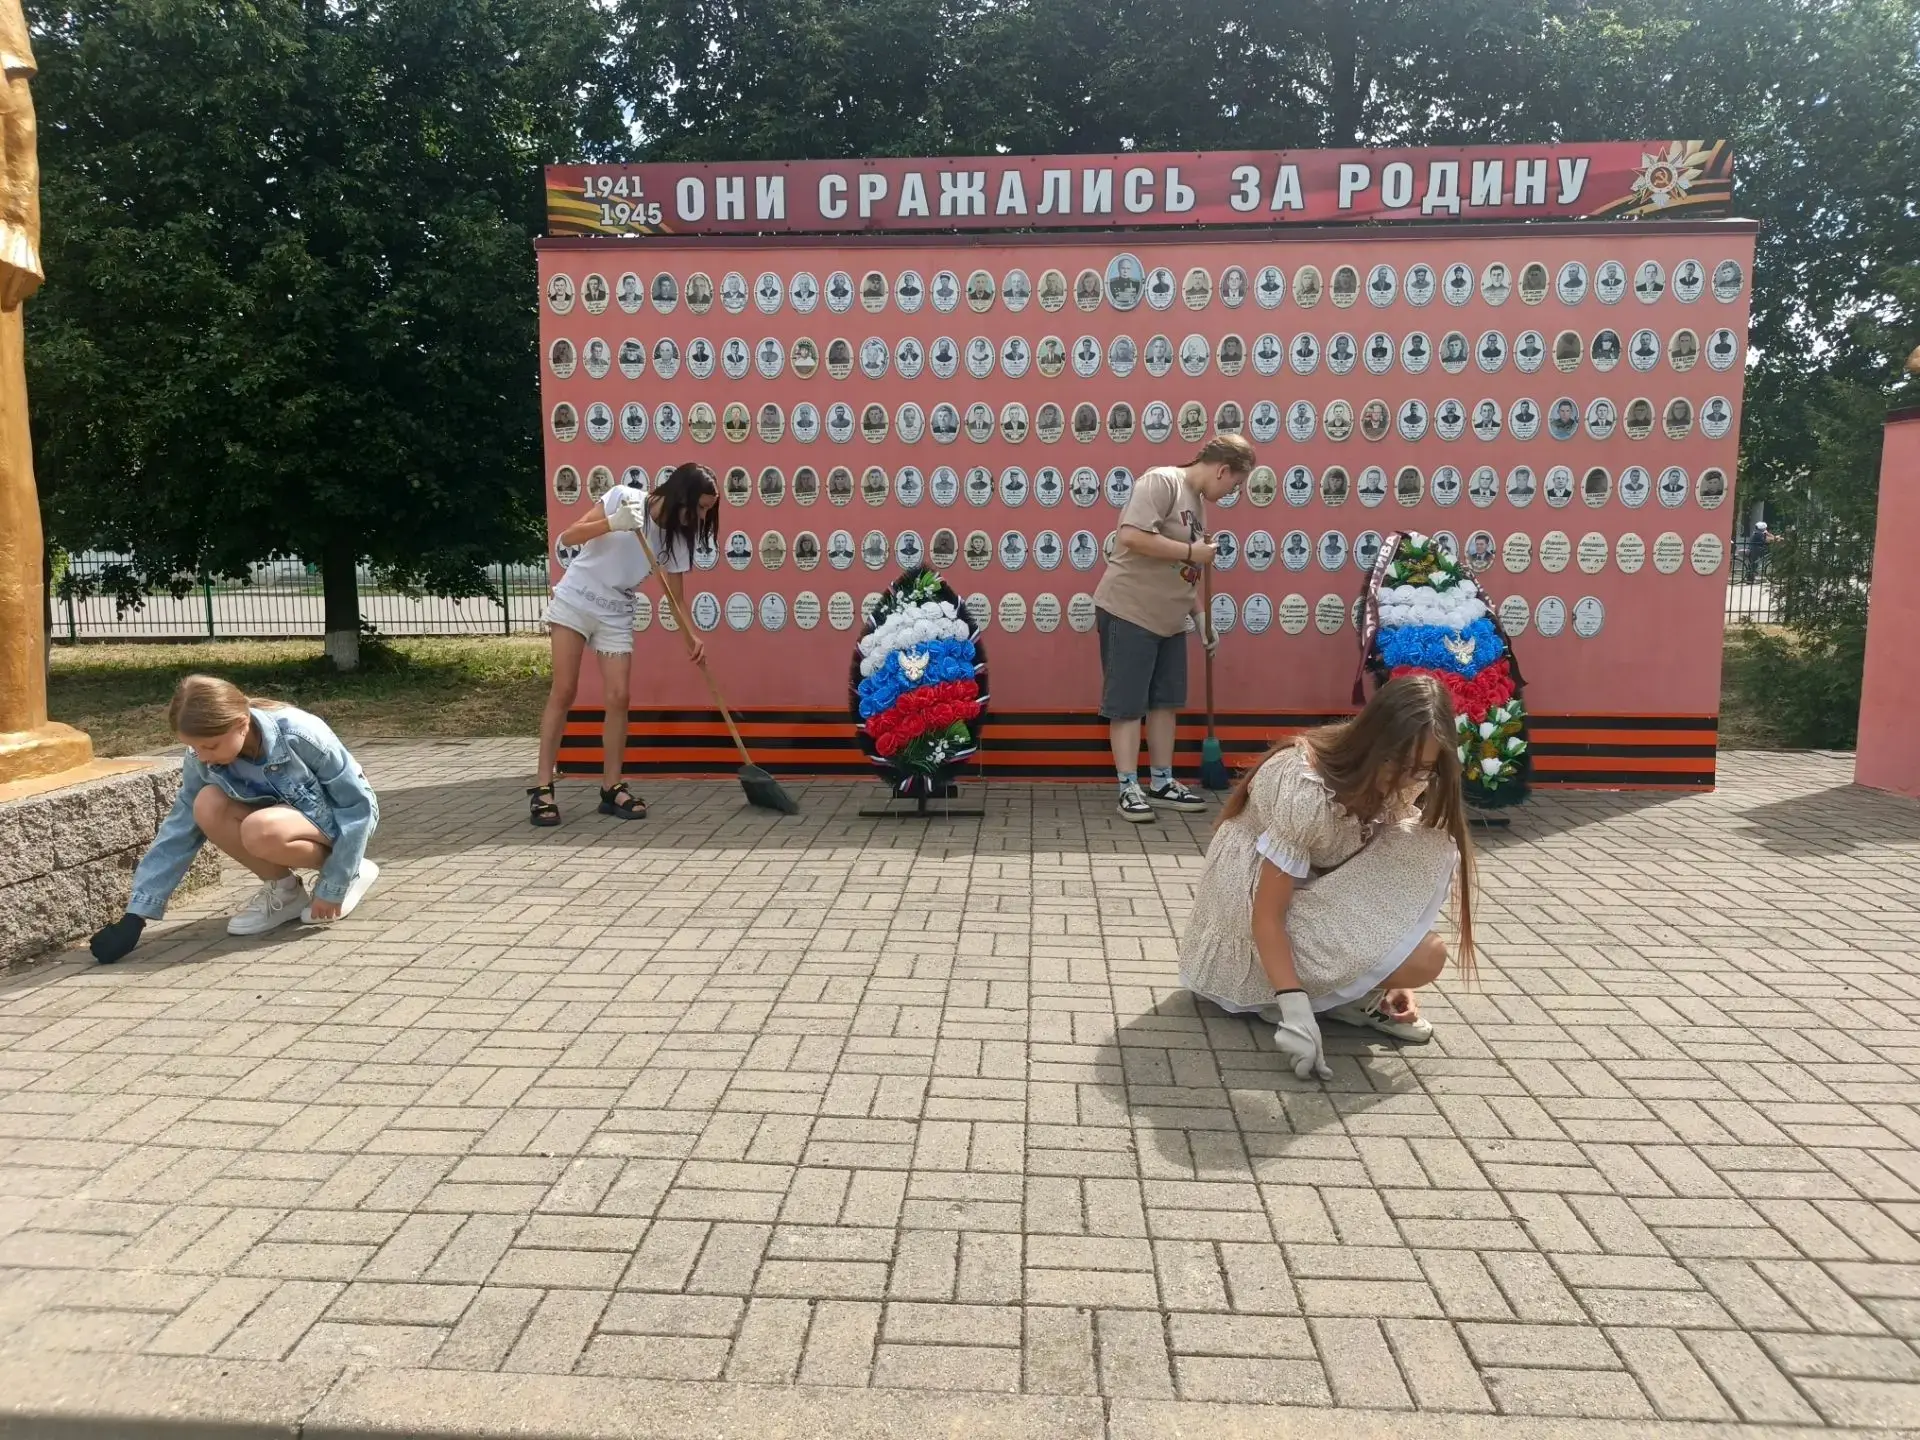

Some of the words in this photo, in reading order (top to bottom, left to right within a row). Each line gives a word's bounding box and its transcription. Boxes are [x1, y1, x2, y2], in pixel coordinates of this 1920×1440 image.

[583, 175, 644, 199] 1941
[675, 175, 785, 223] ОНИ
[817, 166, 1197, 219] СРАЖАЛИСЬ
[1229, 163, 1305, 212] ЗА
[1337, 157, 1591, 216] РОДИНУ
[600, 202, 663, 226] 1945
